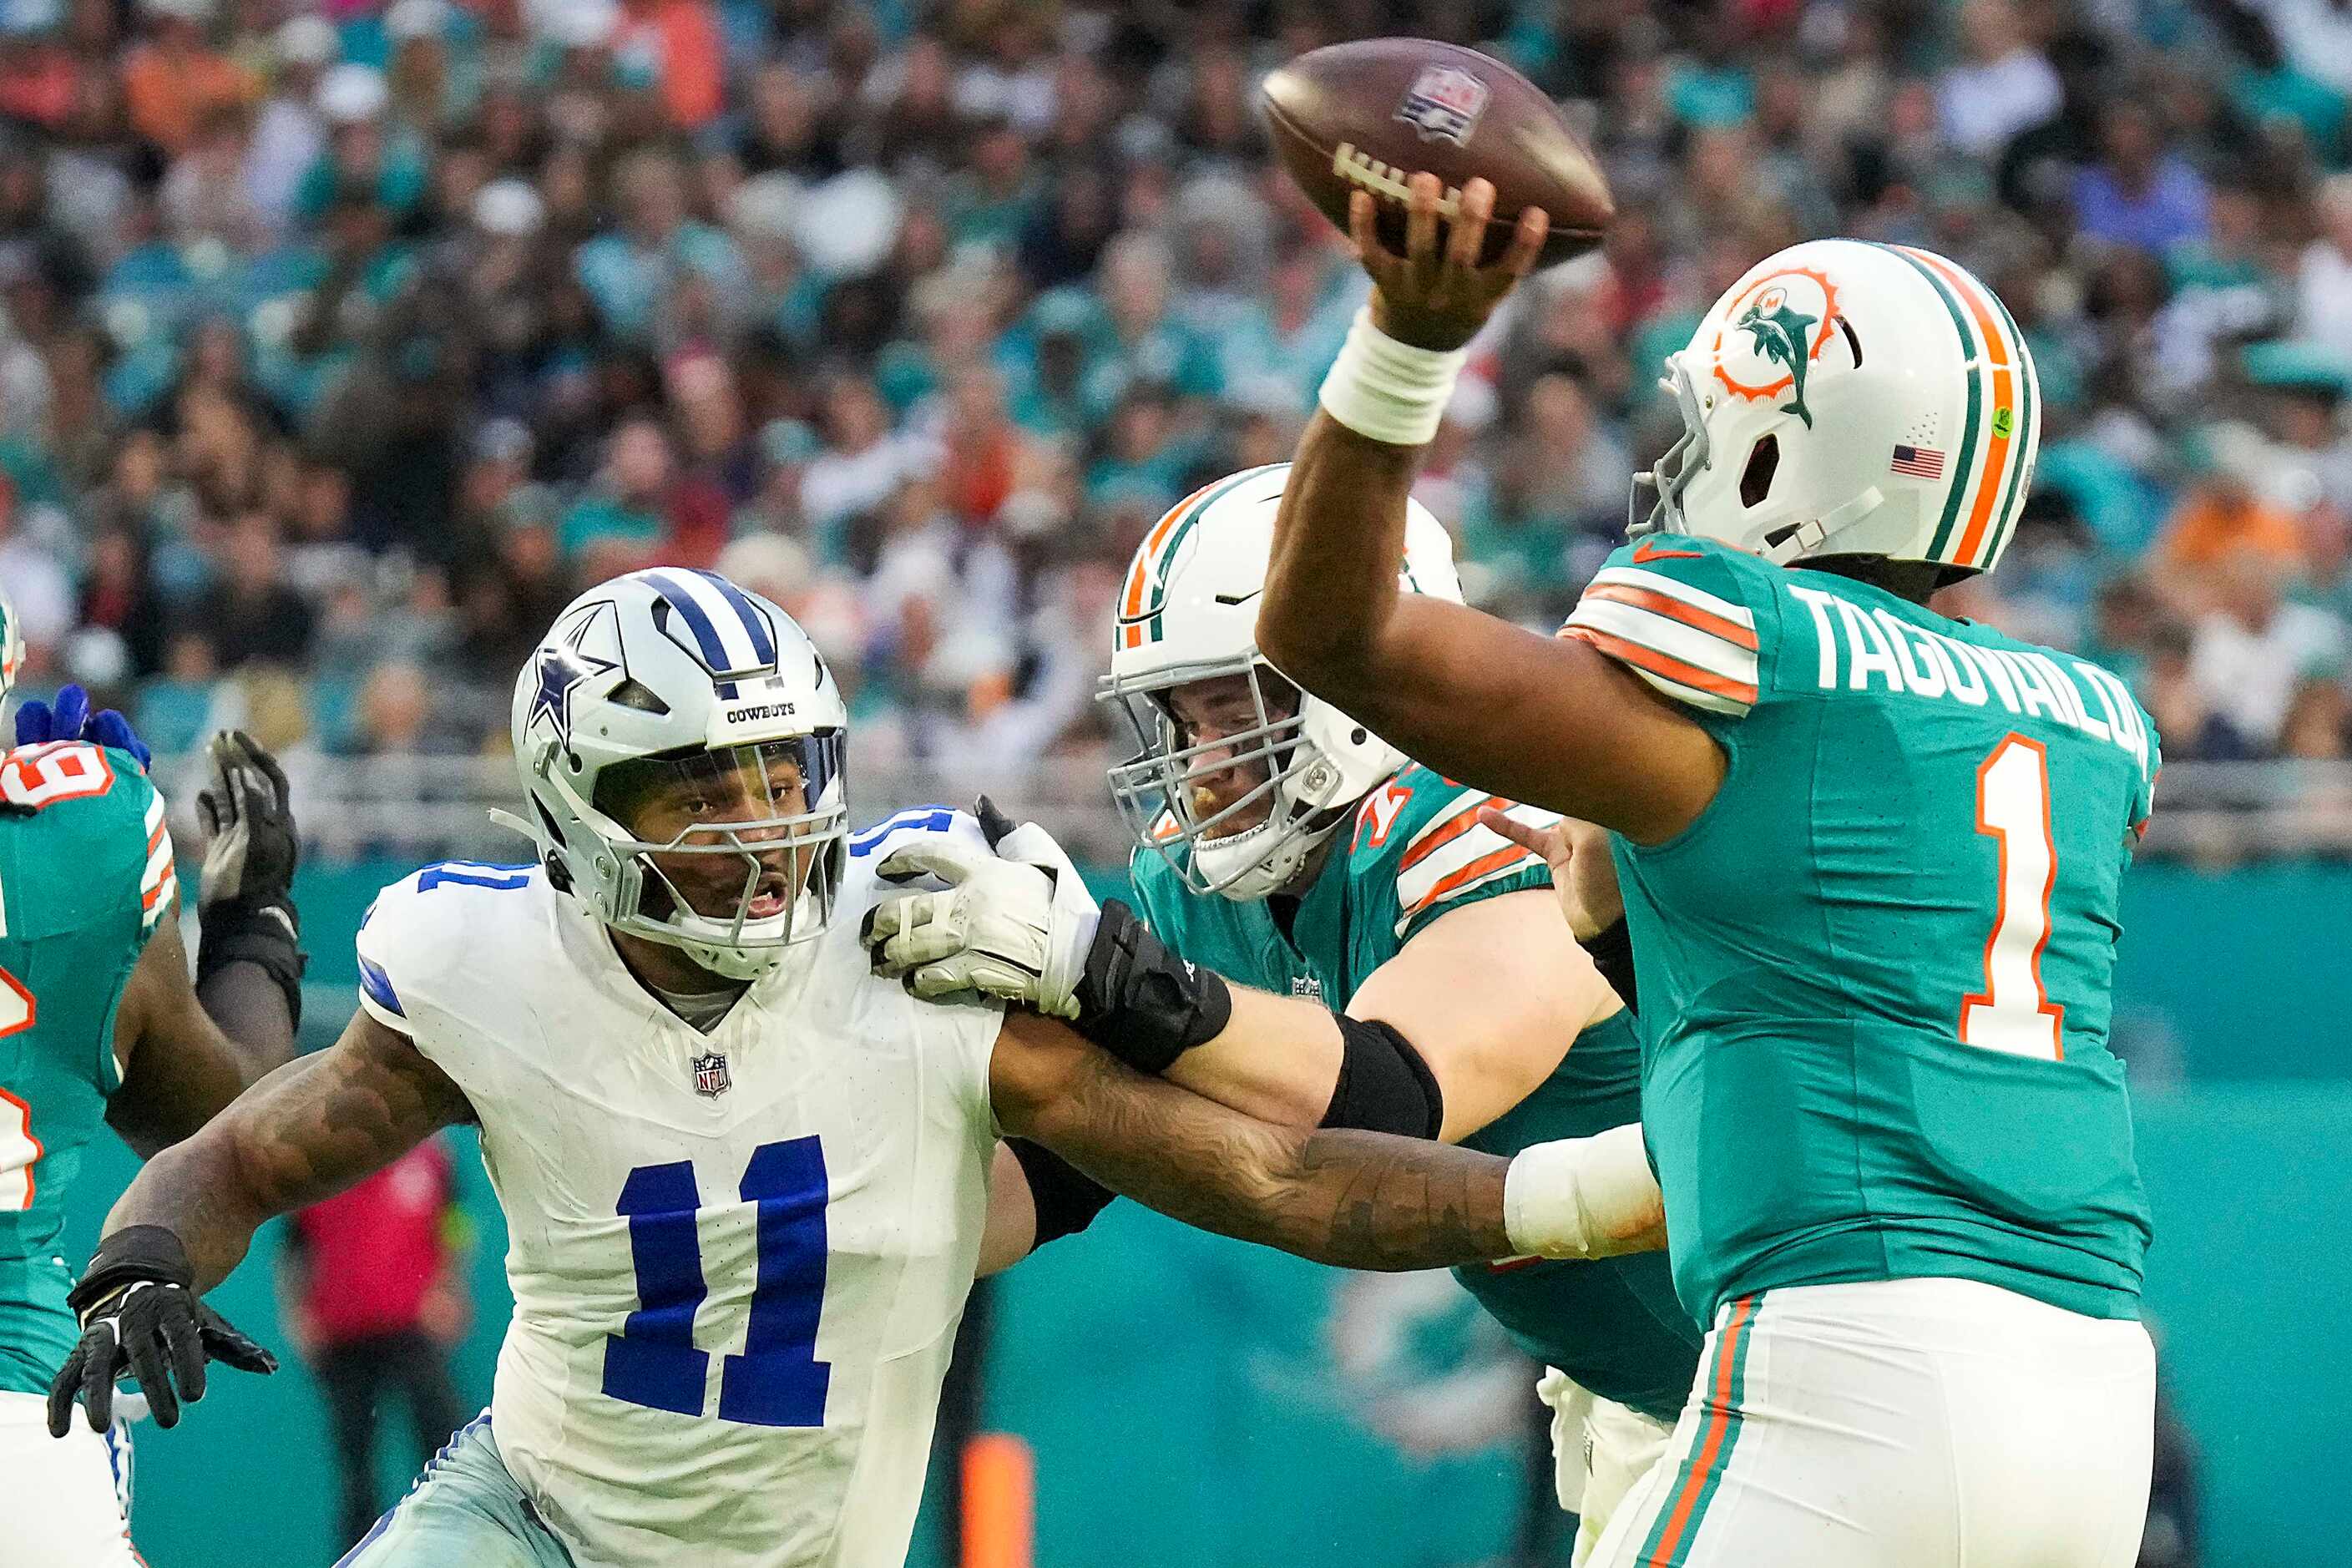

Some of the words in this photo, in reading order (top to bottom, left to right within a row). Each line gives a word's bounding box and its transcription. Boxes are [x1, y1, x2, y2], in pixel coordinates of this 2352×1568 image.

[1765, 297, 1779, 308] M
[726, 702, 796, 724] COWBOYS
[1958, 731, 2065, 1061] 1
[697, 1070, 726, 1090] NFL
[600, 1134, 832, 1428] 11
